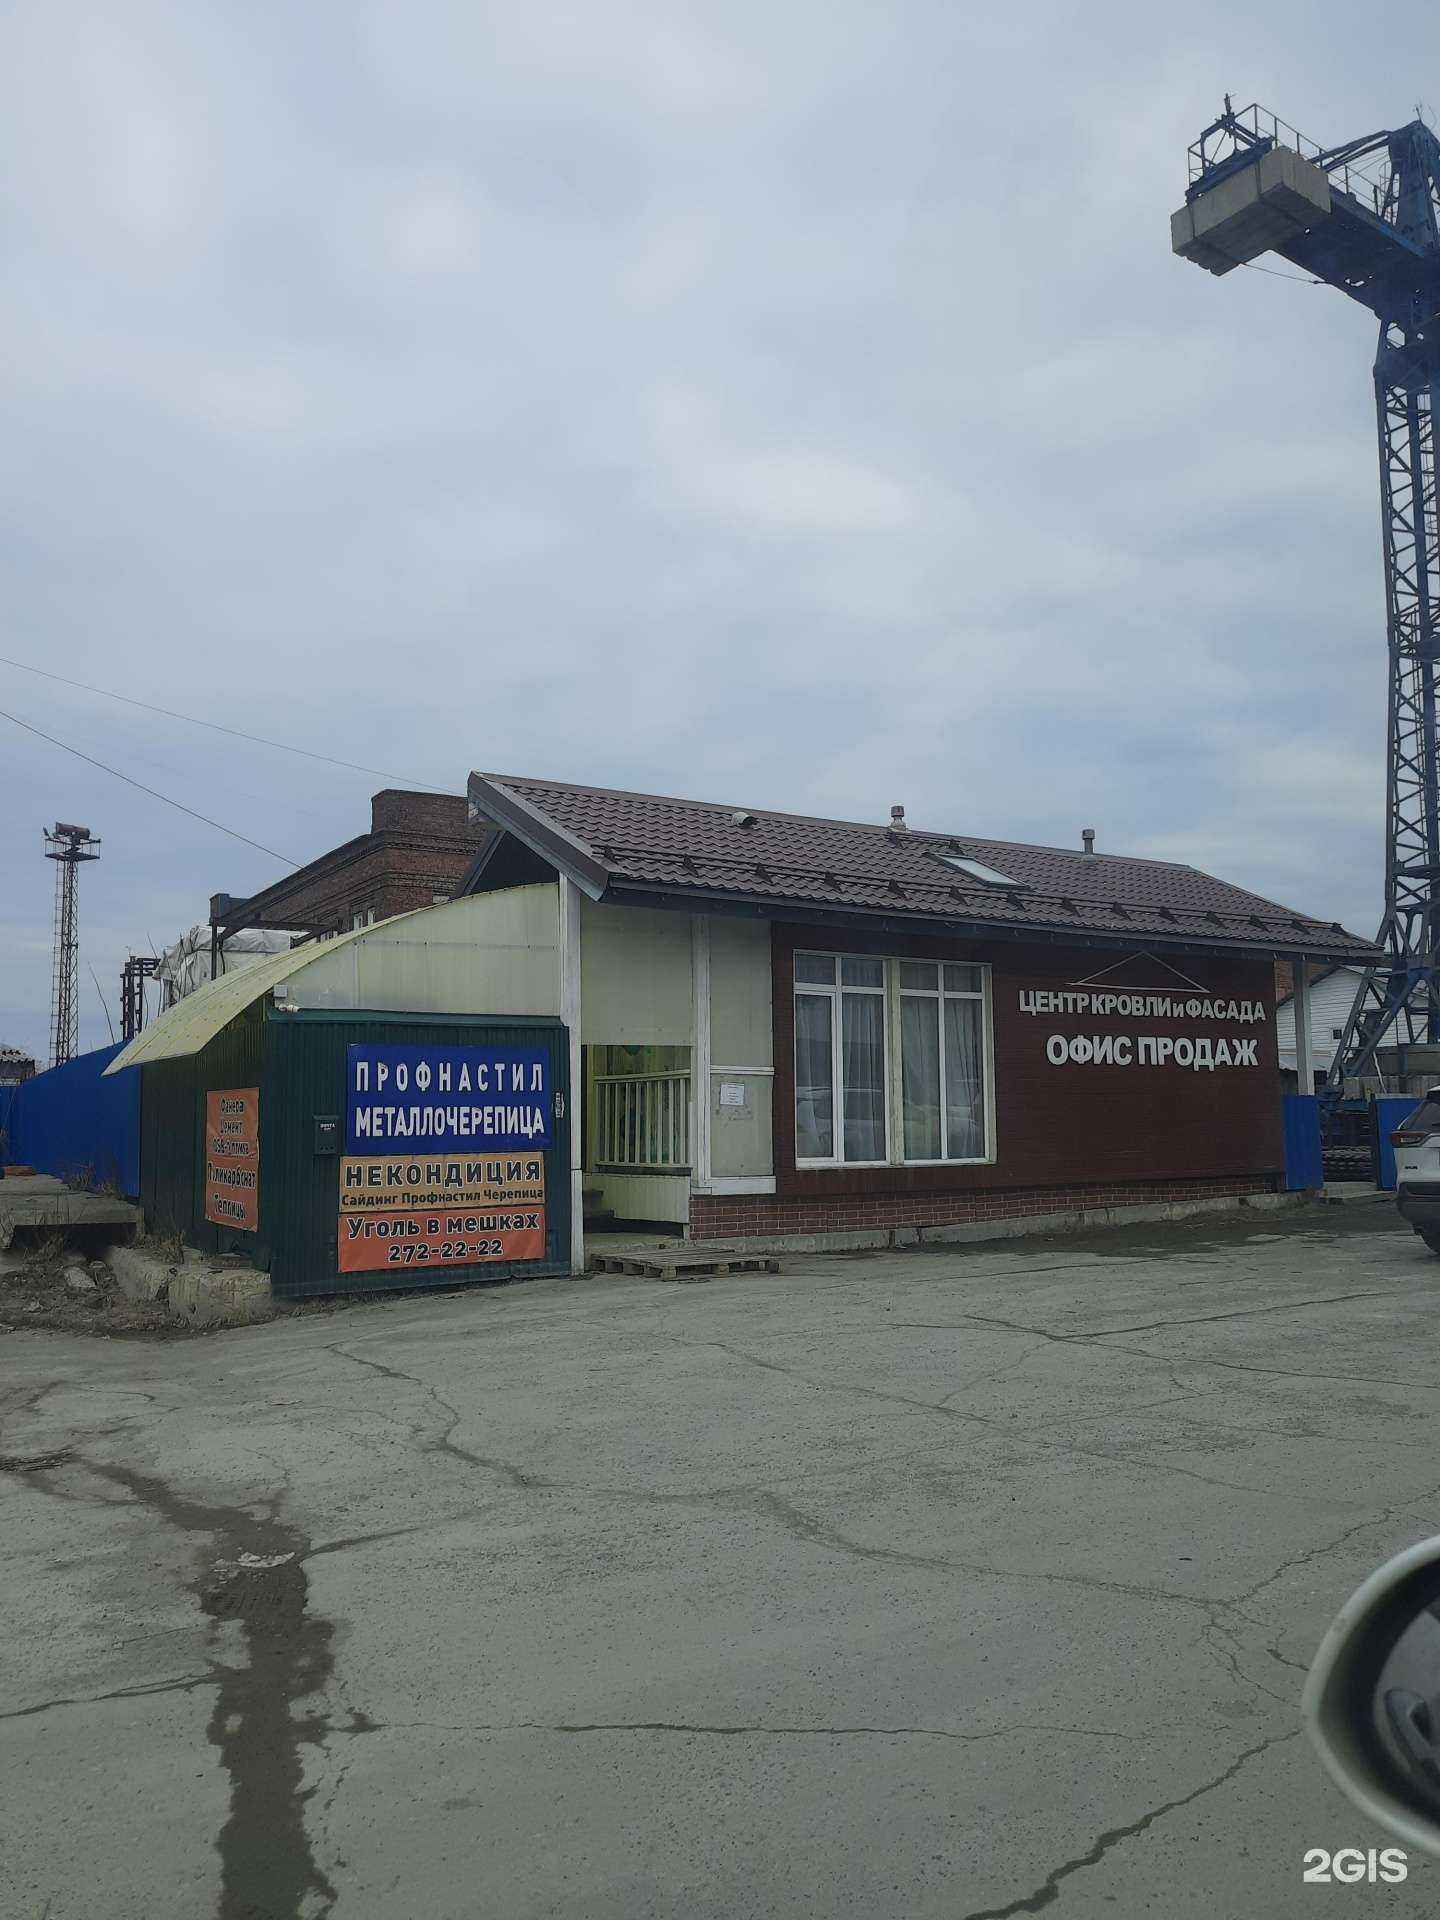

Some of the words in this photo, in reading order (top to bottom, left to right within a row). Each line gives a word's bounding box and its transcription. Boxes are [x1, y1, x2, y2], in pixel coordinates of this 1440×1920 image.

[1018, 990, 1089, 1016] ЦЕНТР
[1091, 993, 1171, 1018] КРОВЛИ
[1185, 999, 1267, 1024] ФАСАДА
[1046, 1034, 1132, 1066] ОФИС
[1137, 1036, 1259, 1072] ПРОДАЖ
[356, 1061, 543, 1092] ПРОФНАСТИЛ
[355, 1106, 545, 1139] МЕТАЛЛОЧЕРЕПИЦА
[345, 1160, 541, 1188] НЕКОНДИЦИЯ
[342, 1193, 398, 1208] Сайдинг
[401, 1191, 481, 1205] Профнастил
[483, 1188, 544, 1200] Черепица
[347, 1216, 420, 1239] Уголь
[426, 1217, 440, 1236] в
[446, 1212, 540, 1234] мешках
[387, 1238, 504, 1264] 272-22-22
